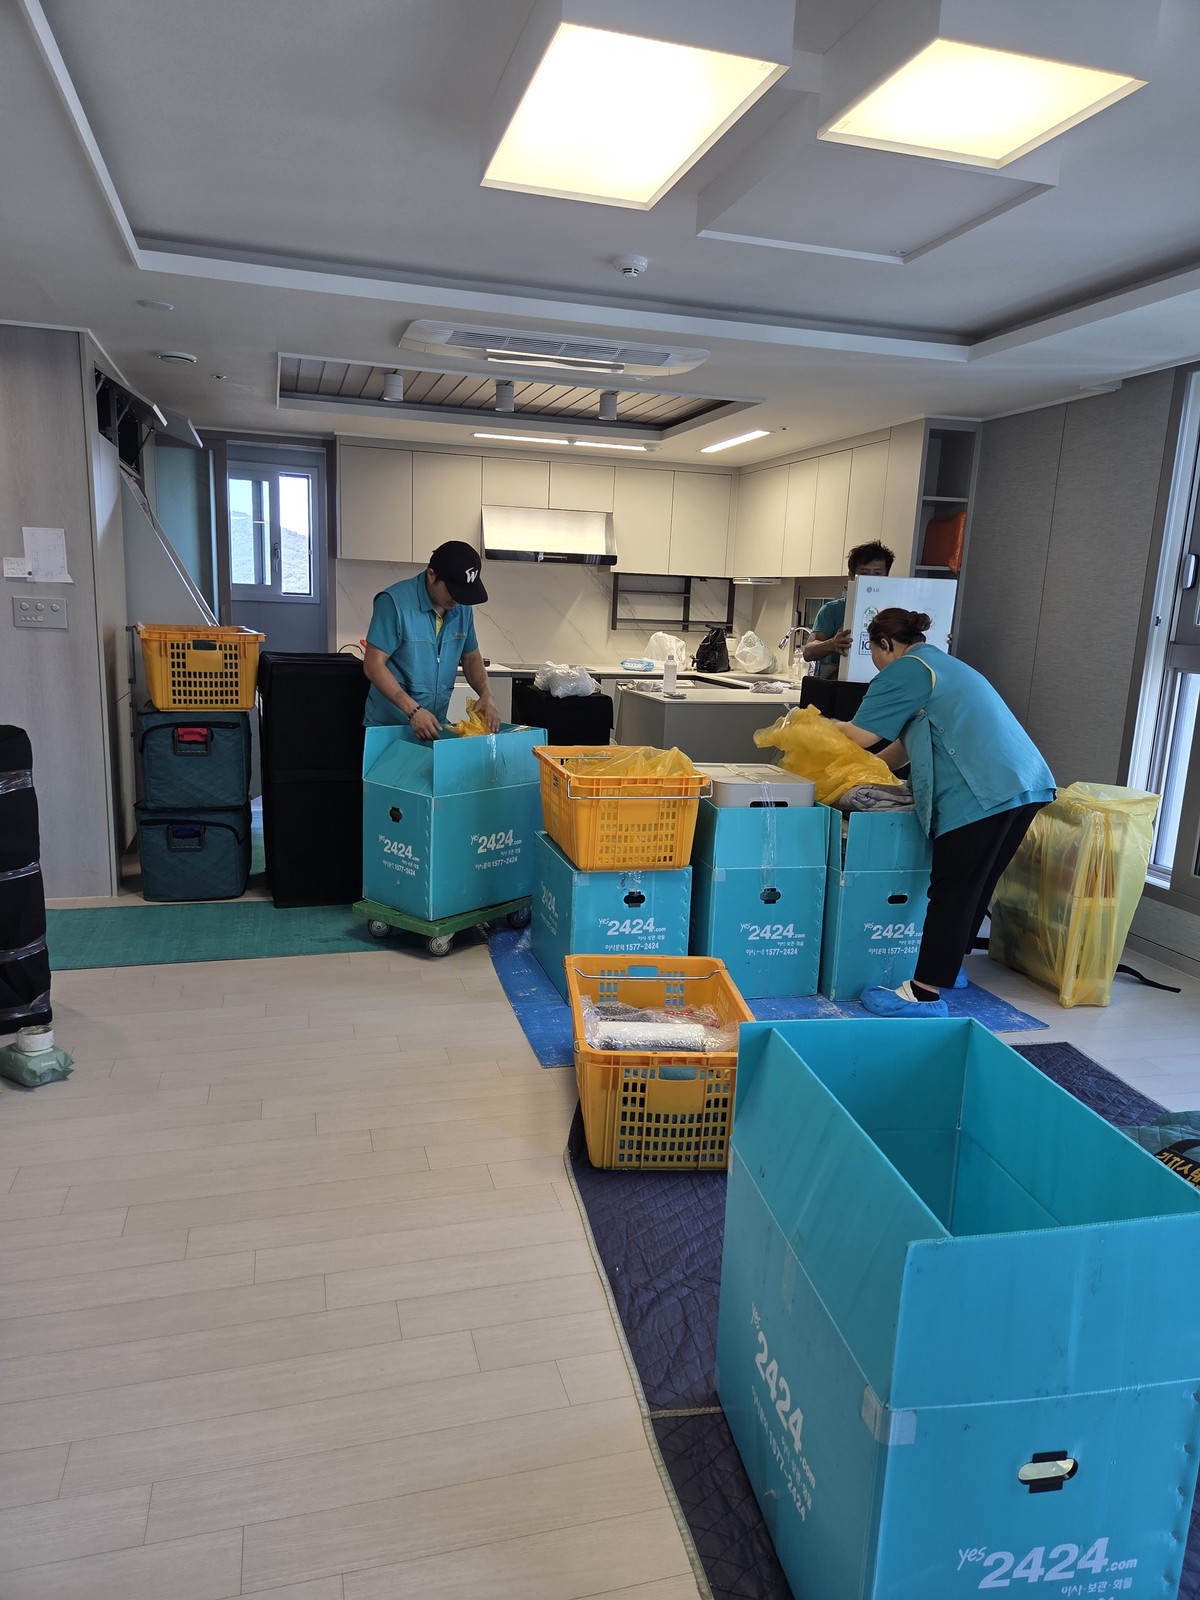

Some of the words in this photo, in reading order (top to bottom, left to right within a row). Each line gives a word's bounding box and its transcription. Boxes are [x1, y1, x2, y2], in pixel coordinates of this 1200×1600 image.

[492, 856, 518, 868] 1577-2424
[626, 942, 659, 951] 1577-2424
[887, 946, 918, 955] 1577-2424
[765, 948, 798, 956] 1577-2424
[769, 1430, 806, 1522] 1577-2424
